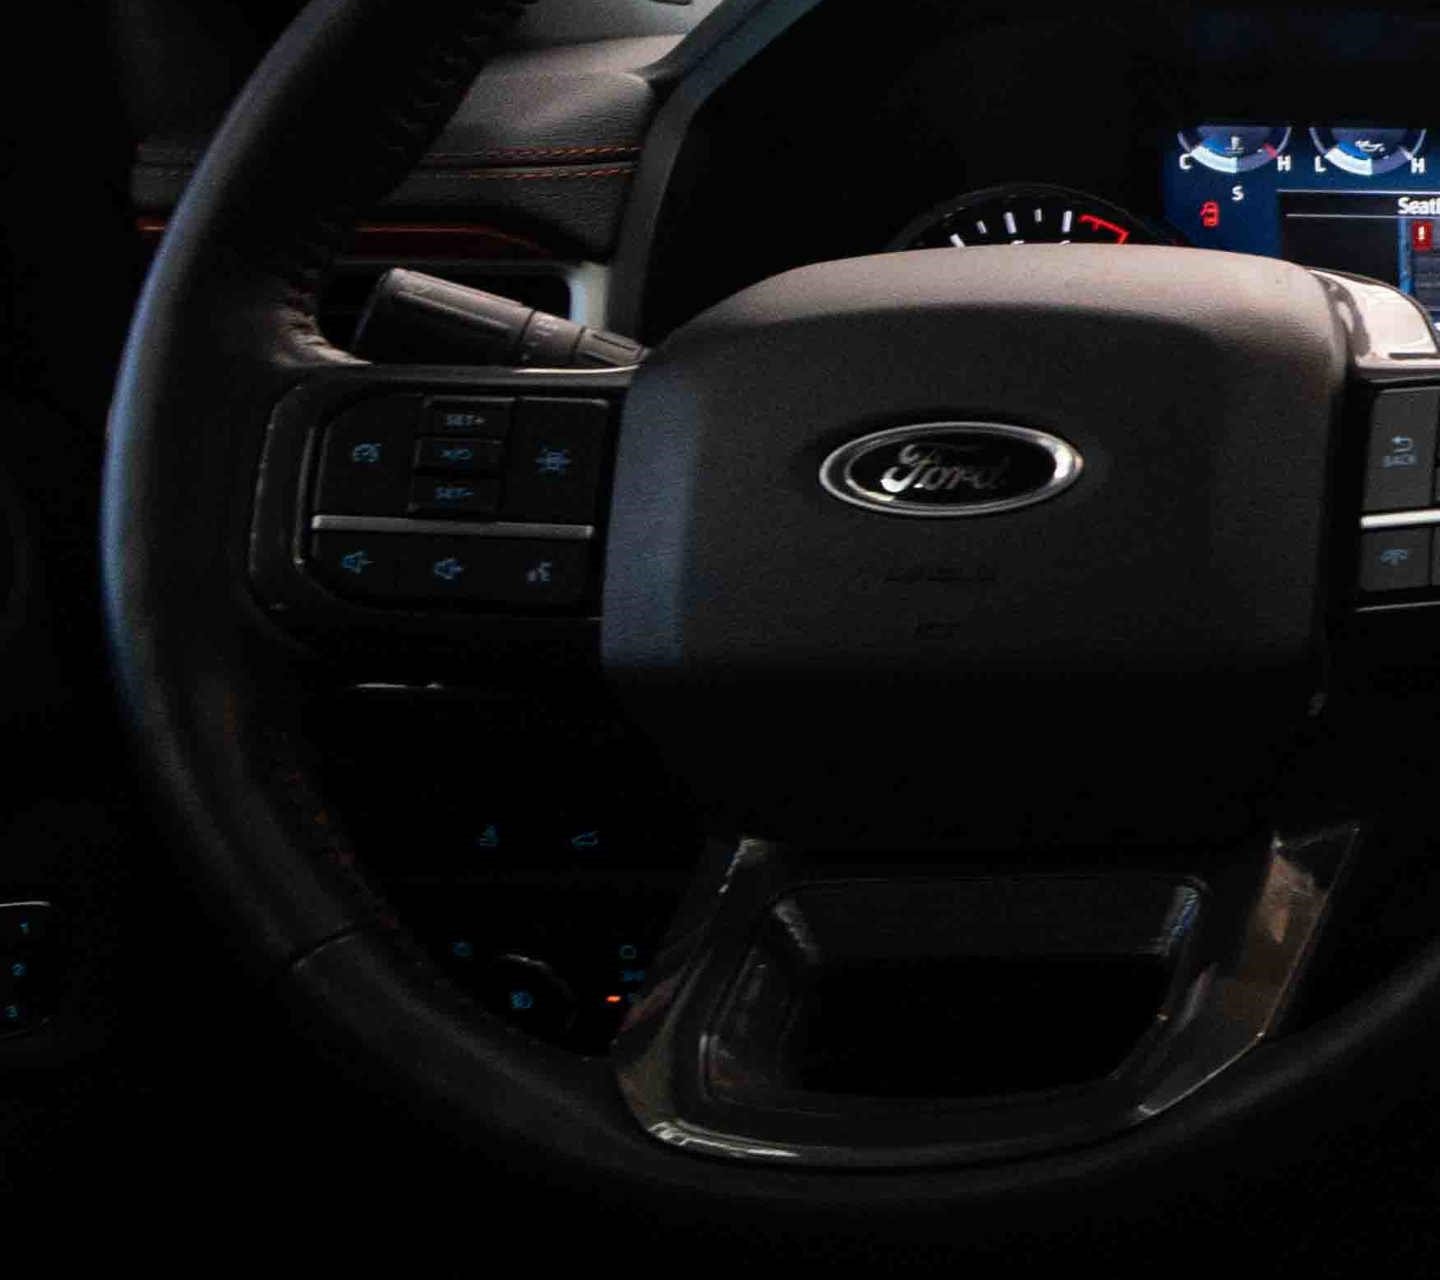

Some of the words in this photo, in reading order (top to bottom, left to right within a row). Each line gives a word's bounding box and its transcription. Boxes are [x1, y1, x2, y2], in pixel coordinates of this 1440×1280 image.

[1179, 155, 1190, 170] C
[1278, 156, 1291, 171] H
[1315, 156, 1326, 172] L
[1411, 157, 1425, 174] H
[880, 443, 1010, 493] Ford
